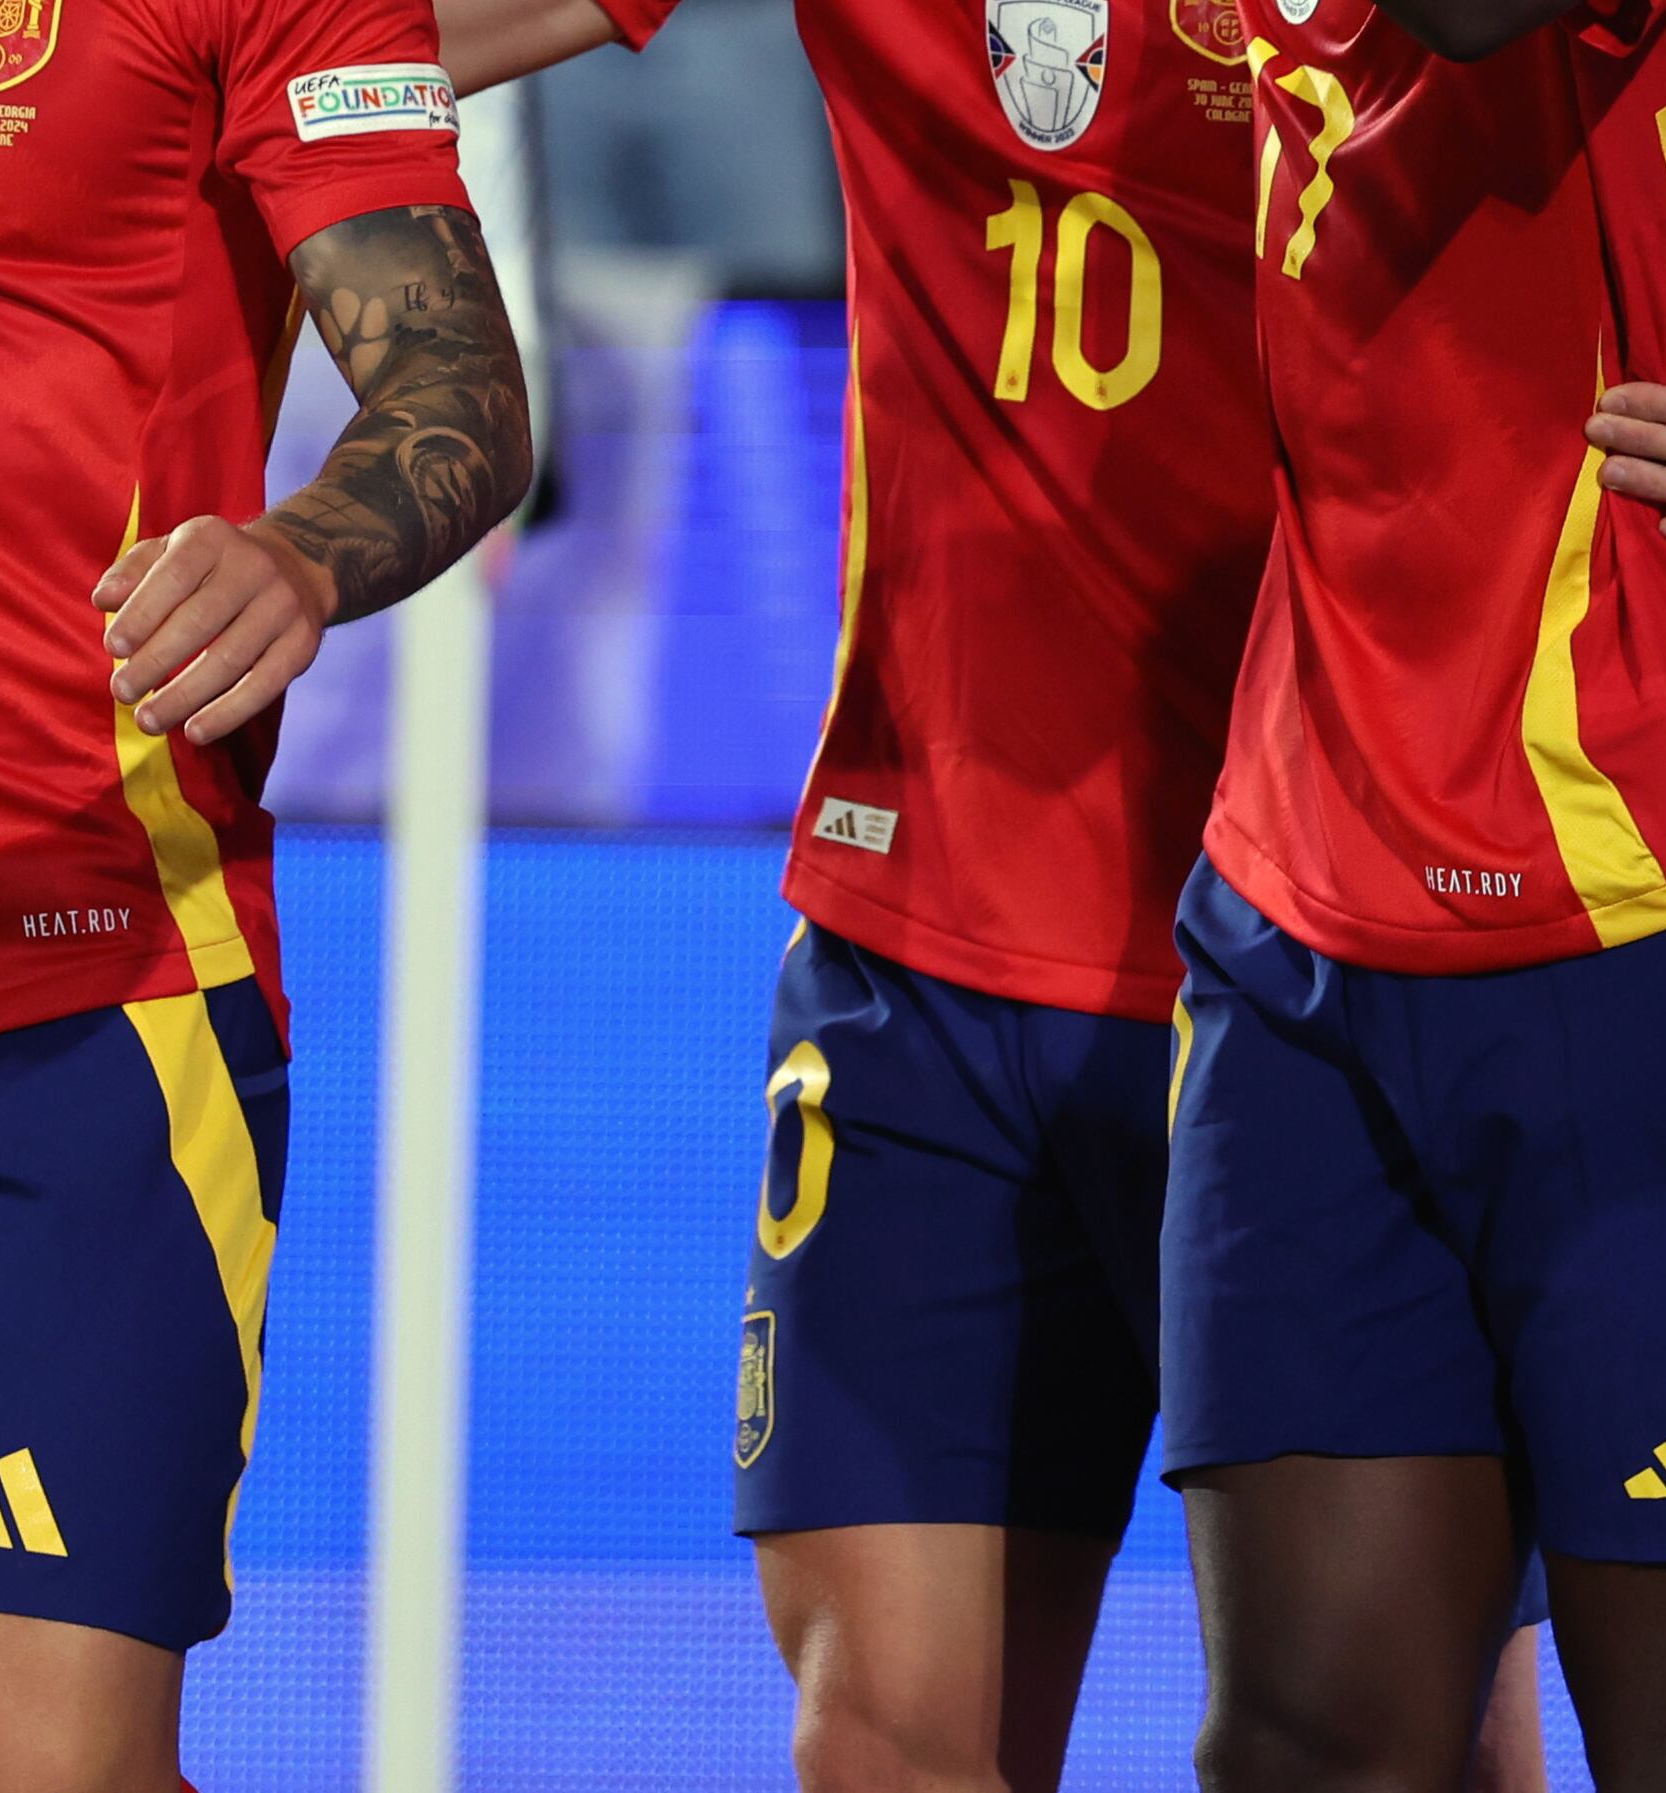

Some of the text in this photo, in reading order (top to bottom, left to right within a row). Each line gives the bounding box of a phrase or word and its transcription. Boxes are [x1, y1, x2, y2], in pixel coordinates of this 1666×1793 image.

[294, 75, 341, 95] UEFA
[0, 119, 28, 133] 2024
[1019, 122, 1052, 143] WINNER
[986, 178, 1162, 411] 10
[1425, 865, 1521, 897] HEAT.RDY
[23, 908, 130, 938] HEAT.RDY
